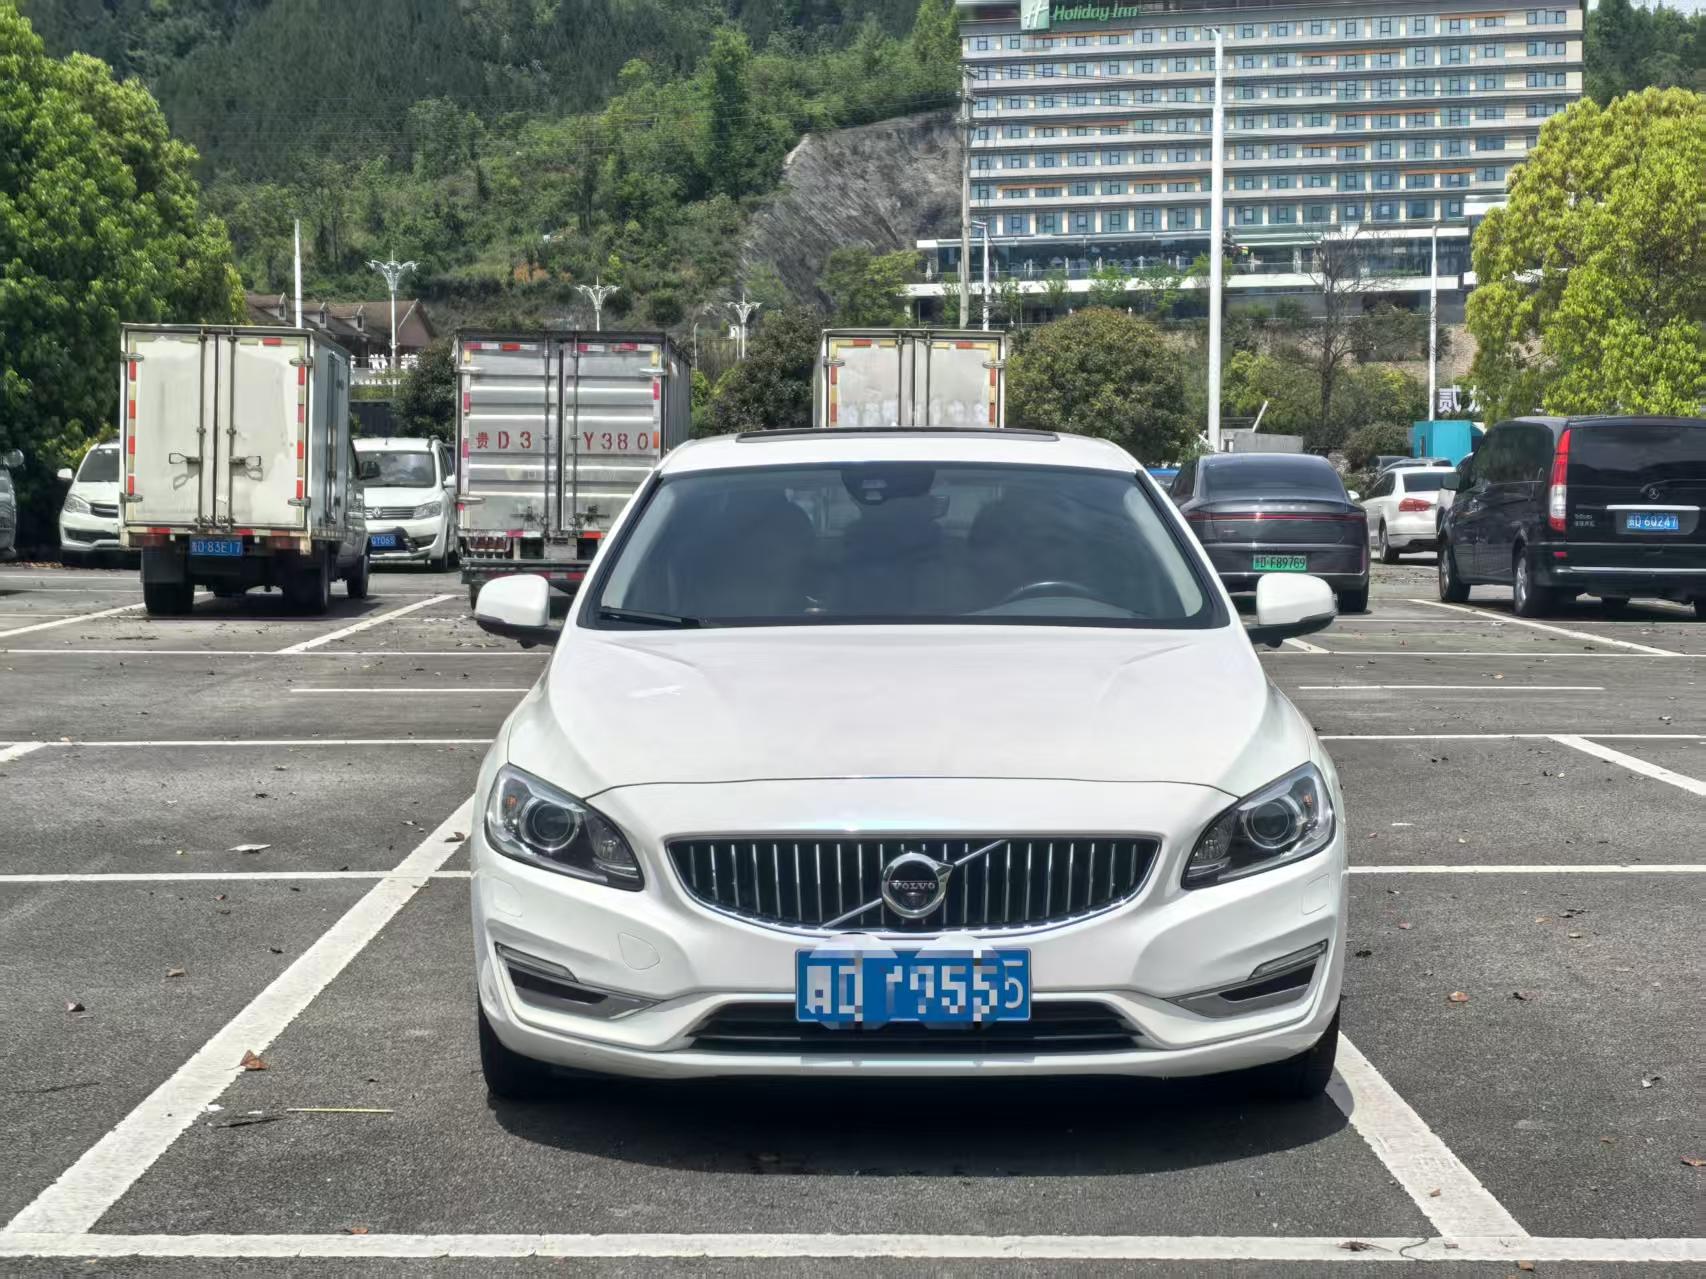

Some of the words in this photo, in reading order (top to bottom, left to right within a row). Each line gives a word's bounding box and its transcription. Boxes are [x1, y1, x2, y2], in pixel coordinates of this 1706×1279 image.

[1054, 3, 1110, 21] Holiday
[1112, 0, 1138, 18] Inn
[583, 431, 648, 450] Y380
[1254, 555, 1306, 570] D·F89769
[891, 882, 936, 891] VOLVO
